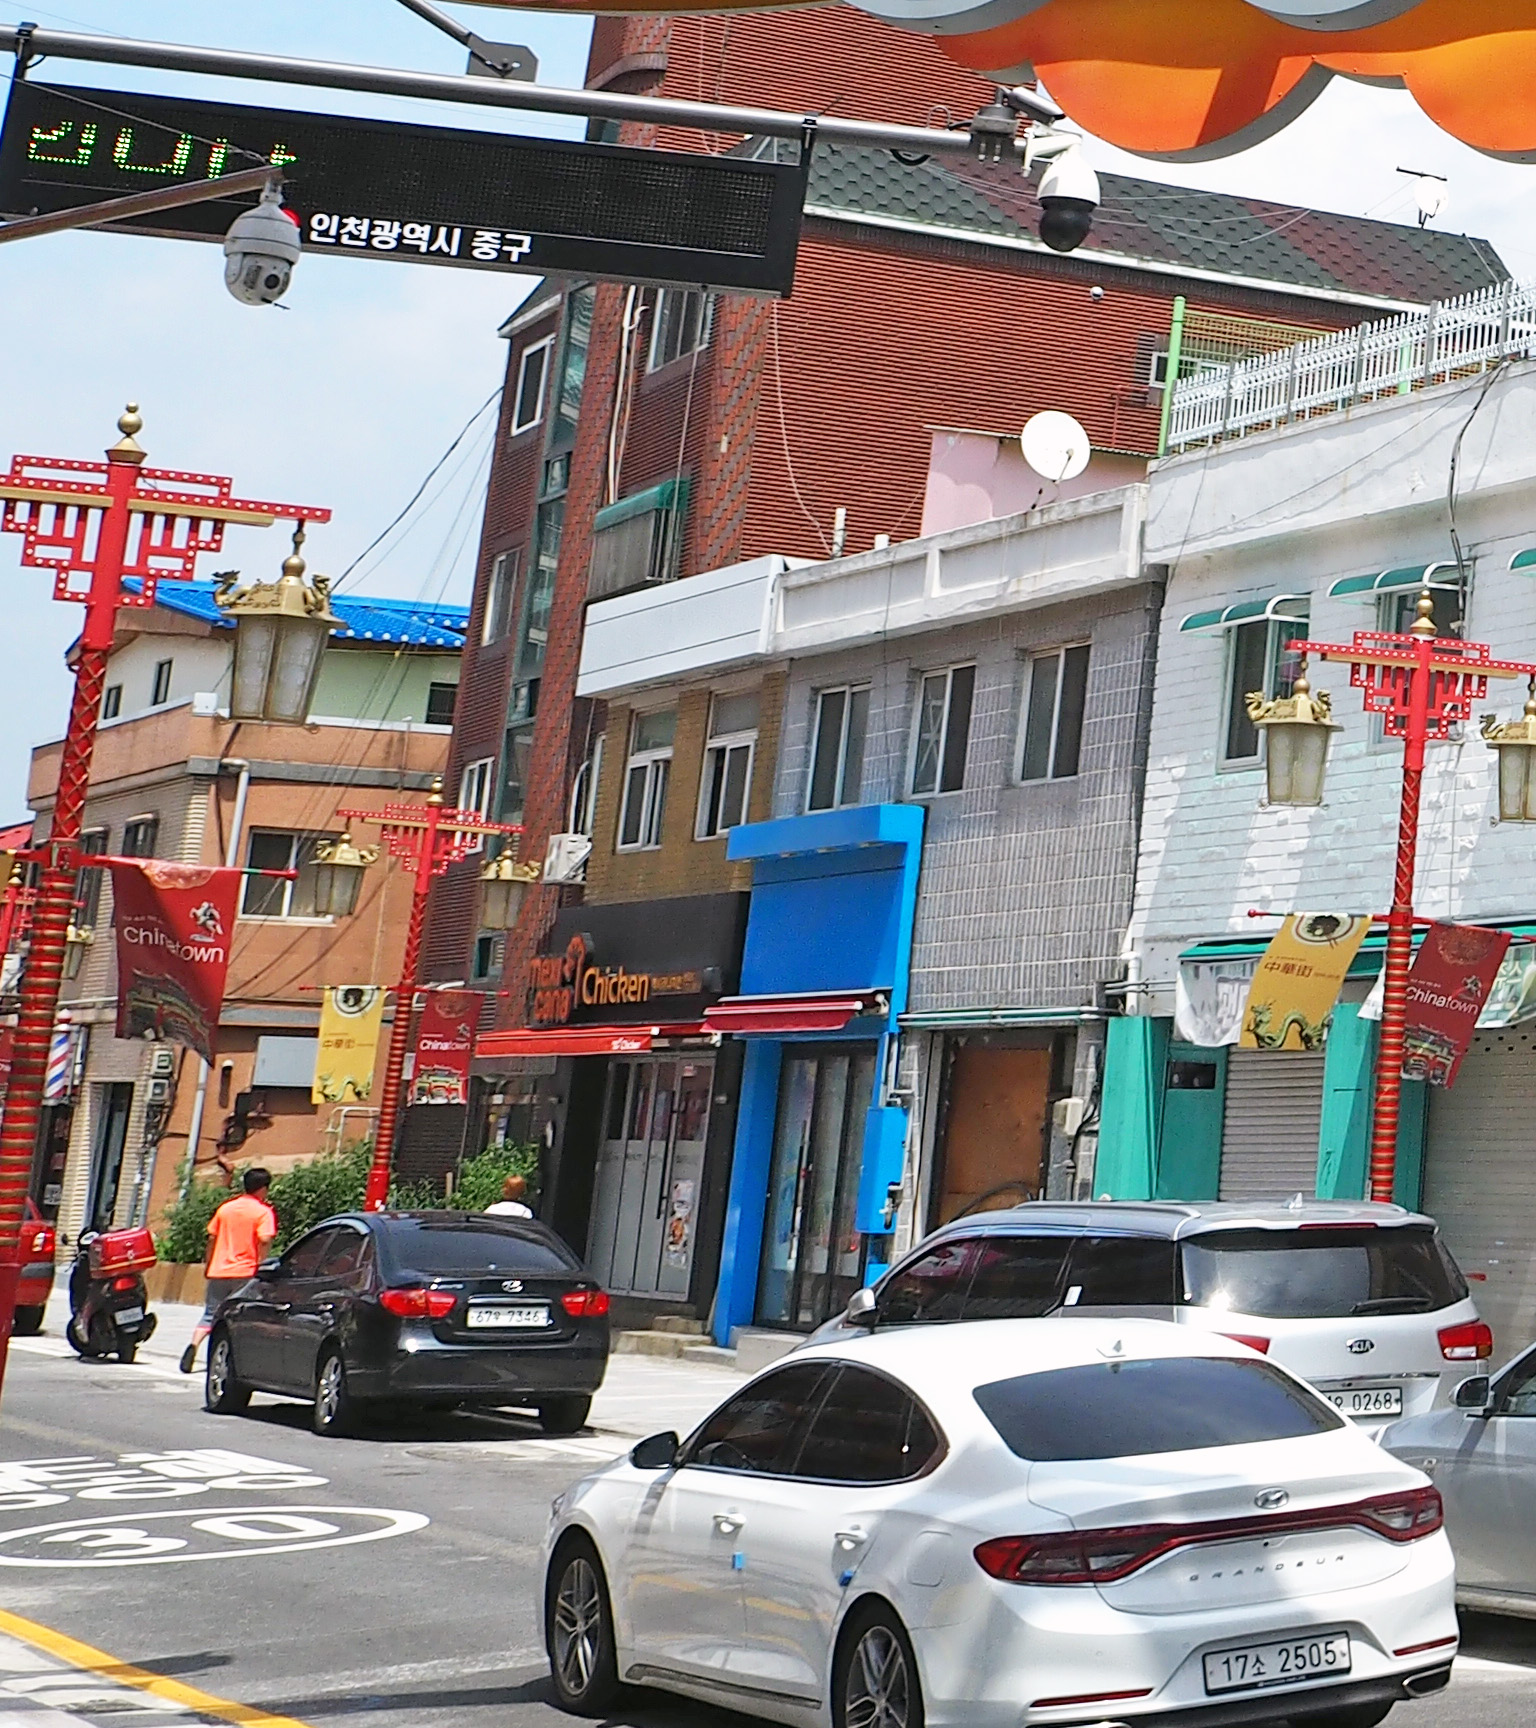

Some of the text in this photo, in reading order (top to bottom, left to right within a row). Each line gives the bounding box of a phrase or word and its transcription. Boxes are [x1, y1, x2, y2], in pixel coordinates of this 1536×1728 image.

[309, 213, 531, 263] 인천광역시 중구
[582, 966, 649, 1005] Chicken
[1405, 985, 1479, 1016] Chinatown
[418, 1039, 471, 1052] Chinatown
[1352, 1340, 1372, 1353] KIA
[1352, 1392, 1393, 1412] 0268
[41, 1514, 341, 1558] 30
[1189, 1554, 1344, 1581] GRANDEUR
[1222, 1654, 1267, 1682] 17소
[1278, 1640, 1337, 1674] 2505
